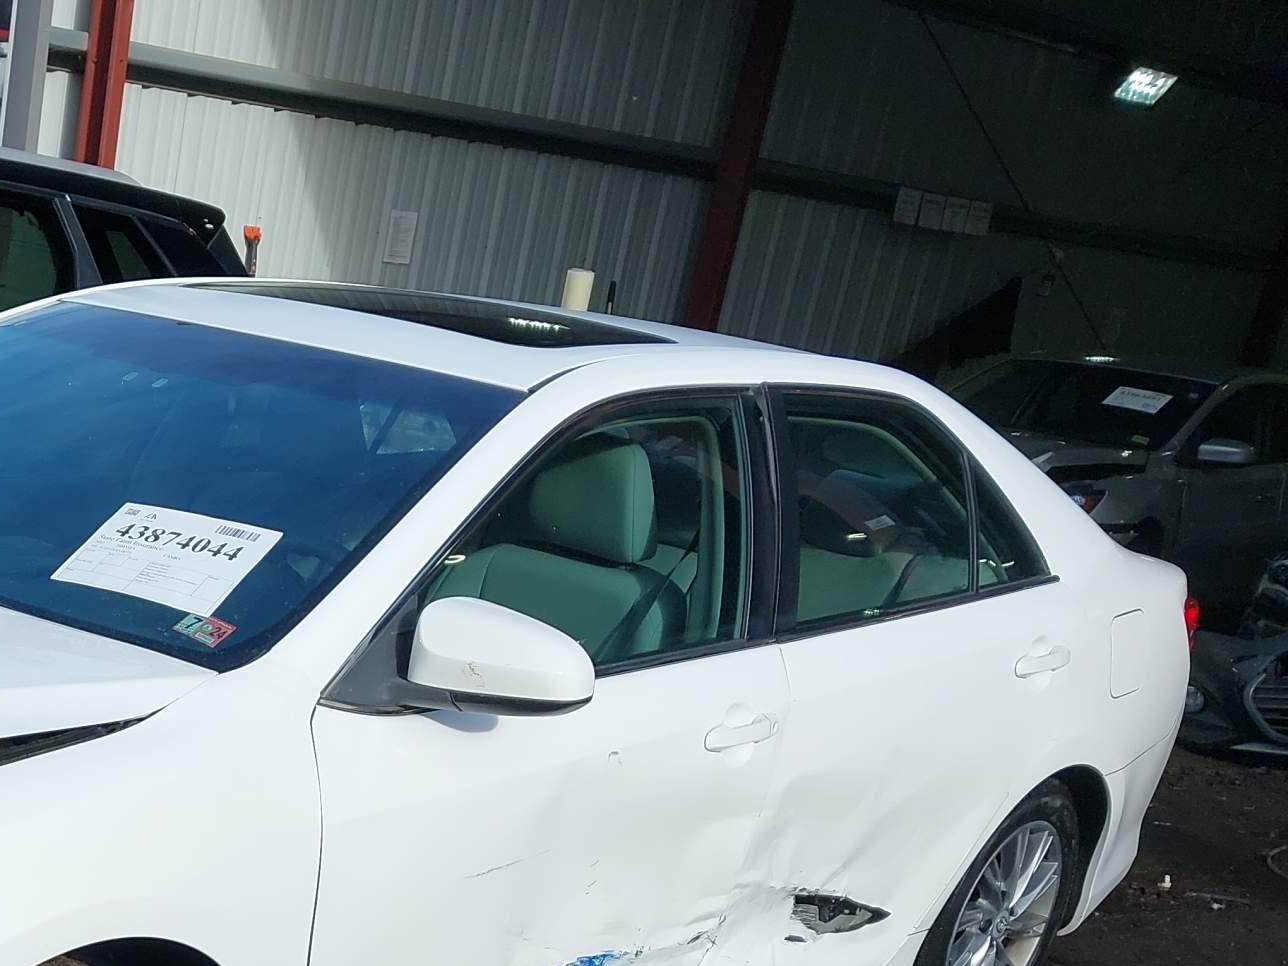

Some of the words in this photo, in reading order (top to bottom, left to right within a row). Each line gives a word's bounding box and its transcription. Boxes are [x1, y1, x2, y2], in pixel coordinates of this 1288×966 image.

[116, 523, 245, 561] 43874044
[185, 616, 204, 629] 7
[209, 626, 228, 640] 24
